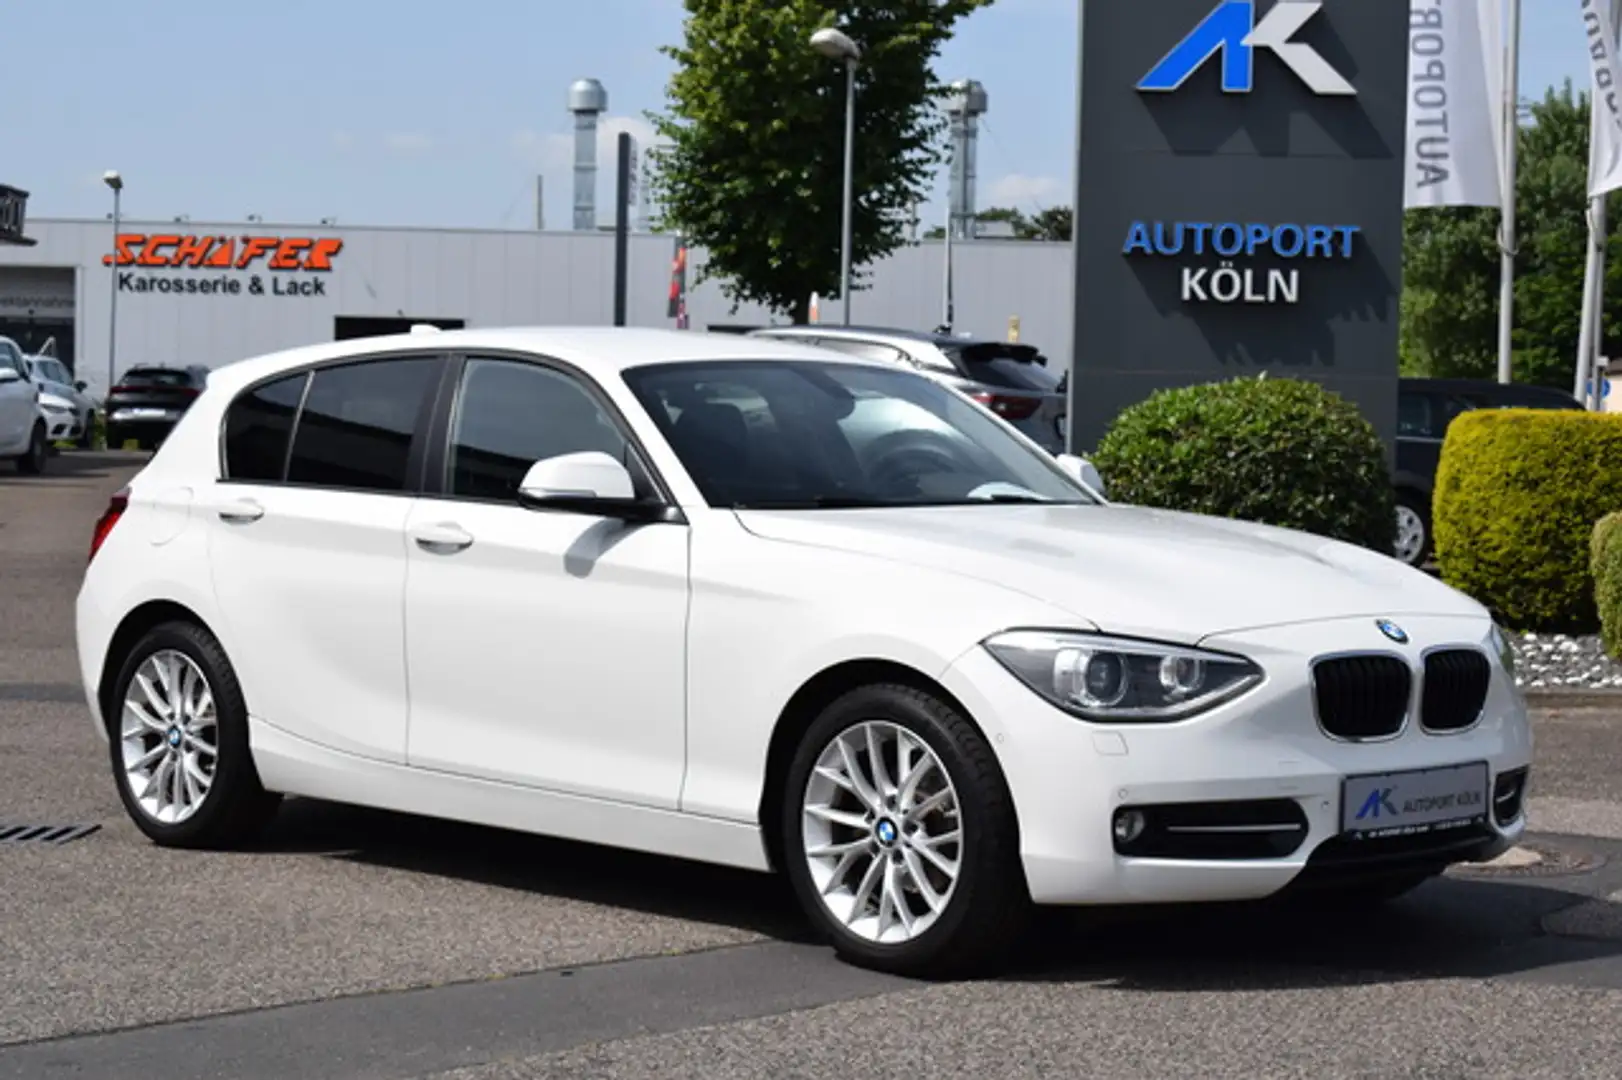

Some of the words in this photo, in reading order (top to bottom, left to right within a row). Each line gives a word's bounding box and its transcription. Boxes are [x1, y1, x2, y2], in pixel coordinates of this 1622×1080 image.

[102, 234, 343, 271] SCHÄFER
[1122, 219, 1361, 257] AUTOPORT
[118, 272, 240, 294] Karosserie
[248, 276, 265, 295] &
[272, 275, 326, 296] Lack
[1181, 260, 1299, 303] KÖLN
